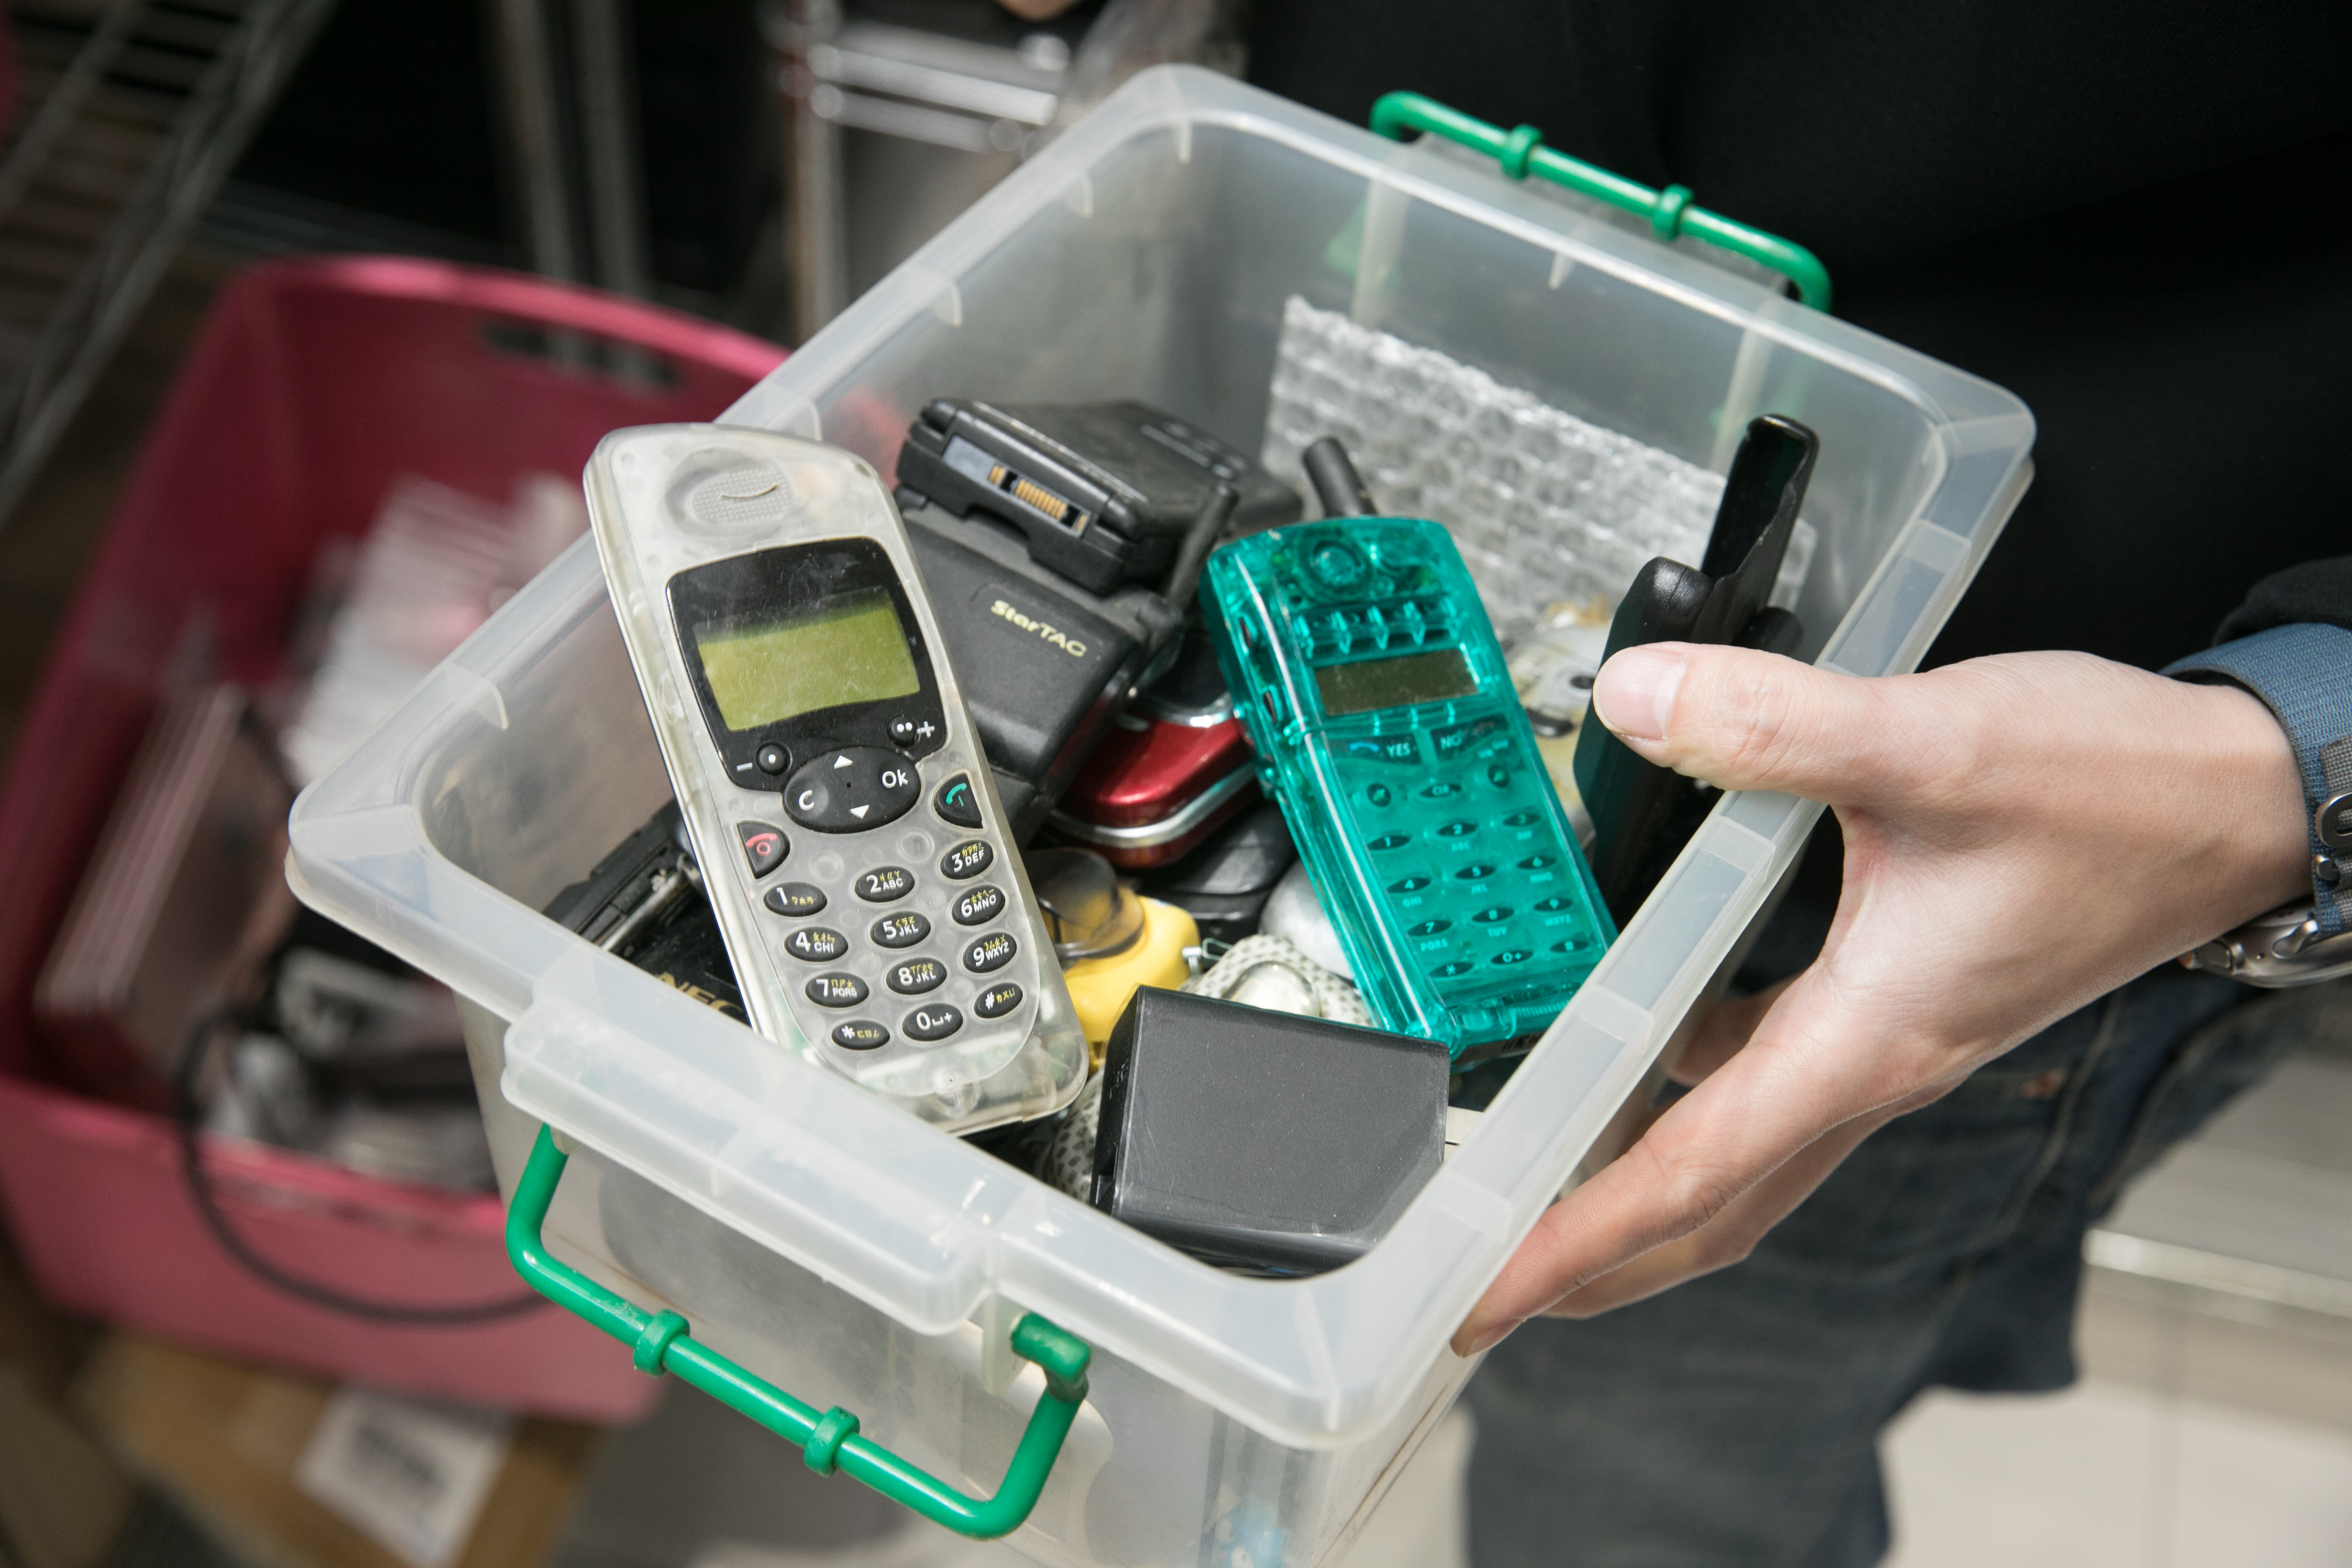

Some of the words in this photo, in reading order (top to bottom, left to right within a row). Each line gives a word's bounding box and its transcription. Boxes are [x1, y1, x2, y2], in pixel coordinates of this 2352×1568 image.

[991, 600, 1087, 658] StarTAC
[1386, 743, 1411, 757] YES
[798, 790, 815, 811] C
[1453, 823, 1463, 835] 2
[1384, 836, 1391, 847] 1
[952, 853, 963, 873] 3
[965, 849, 984, 867] DEF
[1533, 856, 1543, 868] 6
[1472, 866, 1481, 877] 5
[866, 875, 882, 894] 2
[883, 878, 903, 891] ABC
[1405, 879, 1414, 889] 4
[776, 887, 788, 905] 1
[961, 899, 973, 918] 6
[973, 894, 996, 913] MNO
[882, 920, 896, 940] 5
[899, 924, 919, 937] JKL
[1425, 921, 1435, 933] 7
[796, 931, 811, 952] 4
[973, 947, 985, 967] 9
[985, 942, 1009, 961] WXYZ
[898, 967, 913, 986] 8
[916, 971, 937, 983] JKL
[816, 979, 828, 997] 7
